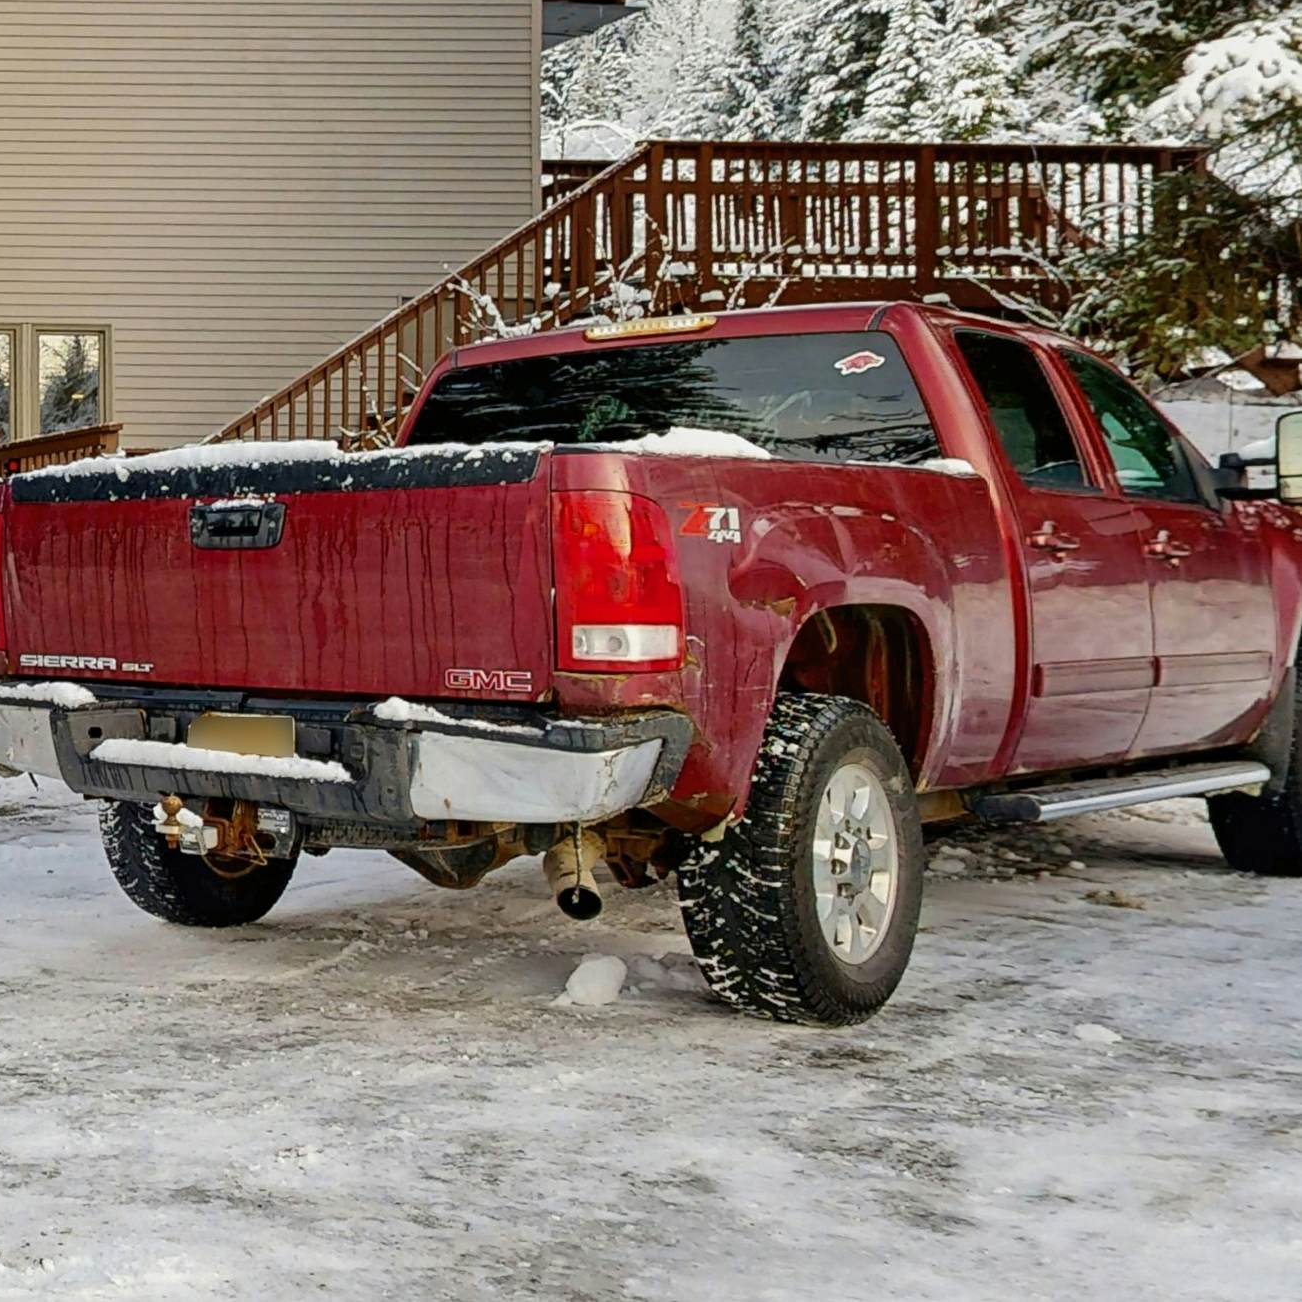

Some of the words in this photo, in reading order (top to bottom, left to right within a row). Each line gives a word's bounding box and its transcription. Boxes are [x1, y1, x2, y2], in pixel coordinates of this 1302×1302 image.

[676, 499, 740, 536] Z71
[19, 654, 117, 671] SIERRA
[121, 662, 154, 673] SLT
[444, 668, 532, 692] GMC
